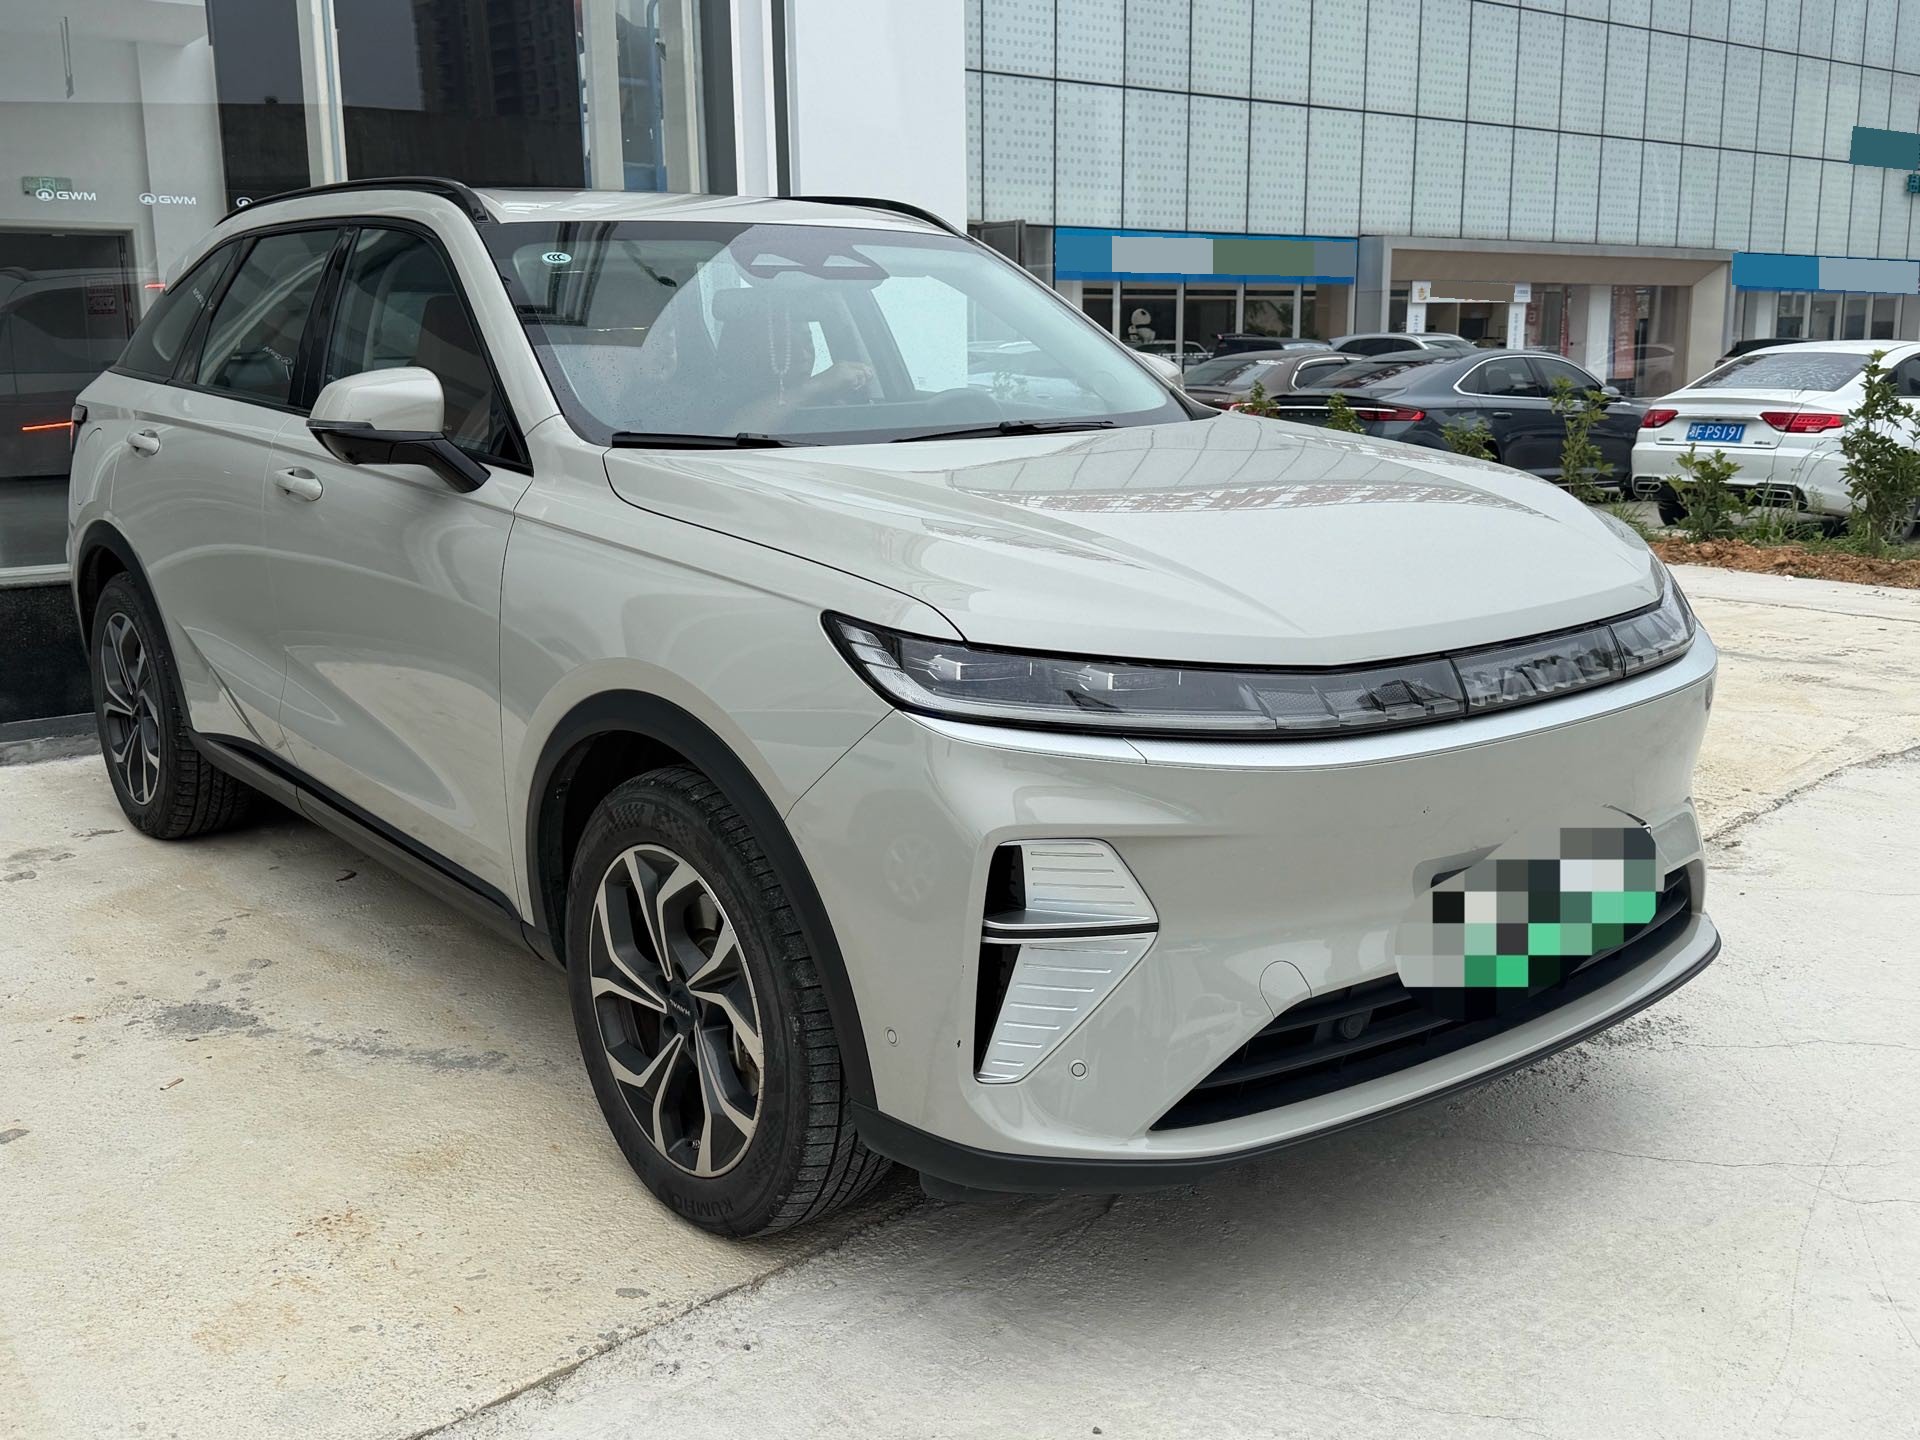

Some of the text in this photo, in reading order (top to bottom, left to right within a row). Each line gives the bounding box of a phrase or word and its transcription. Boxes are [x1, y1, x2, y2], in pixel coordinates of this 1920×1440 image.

[56, 191, 97, 201] GWM
[158, 195, 197, 205] GWM
[1463, 650, 1611, 707] HAVAL
